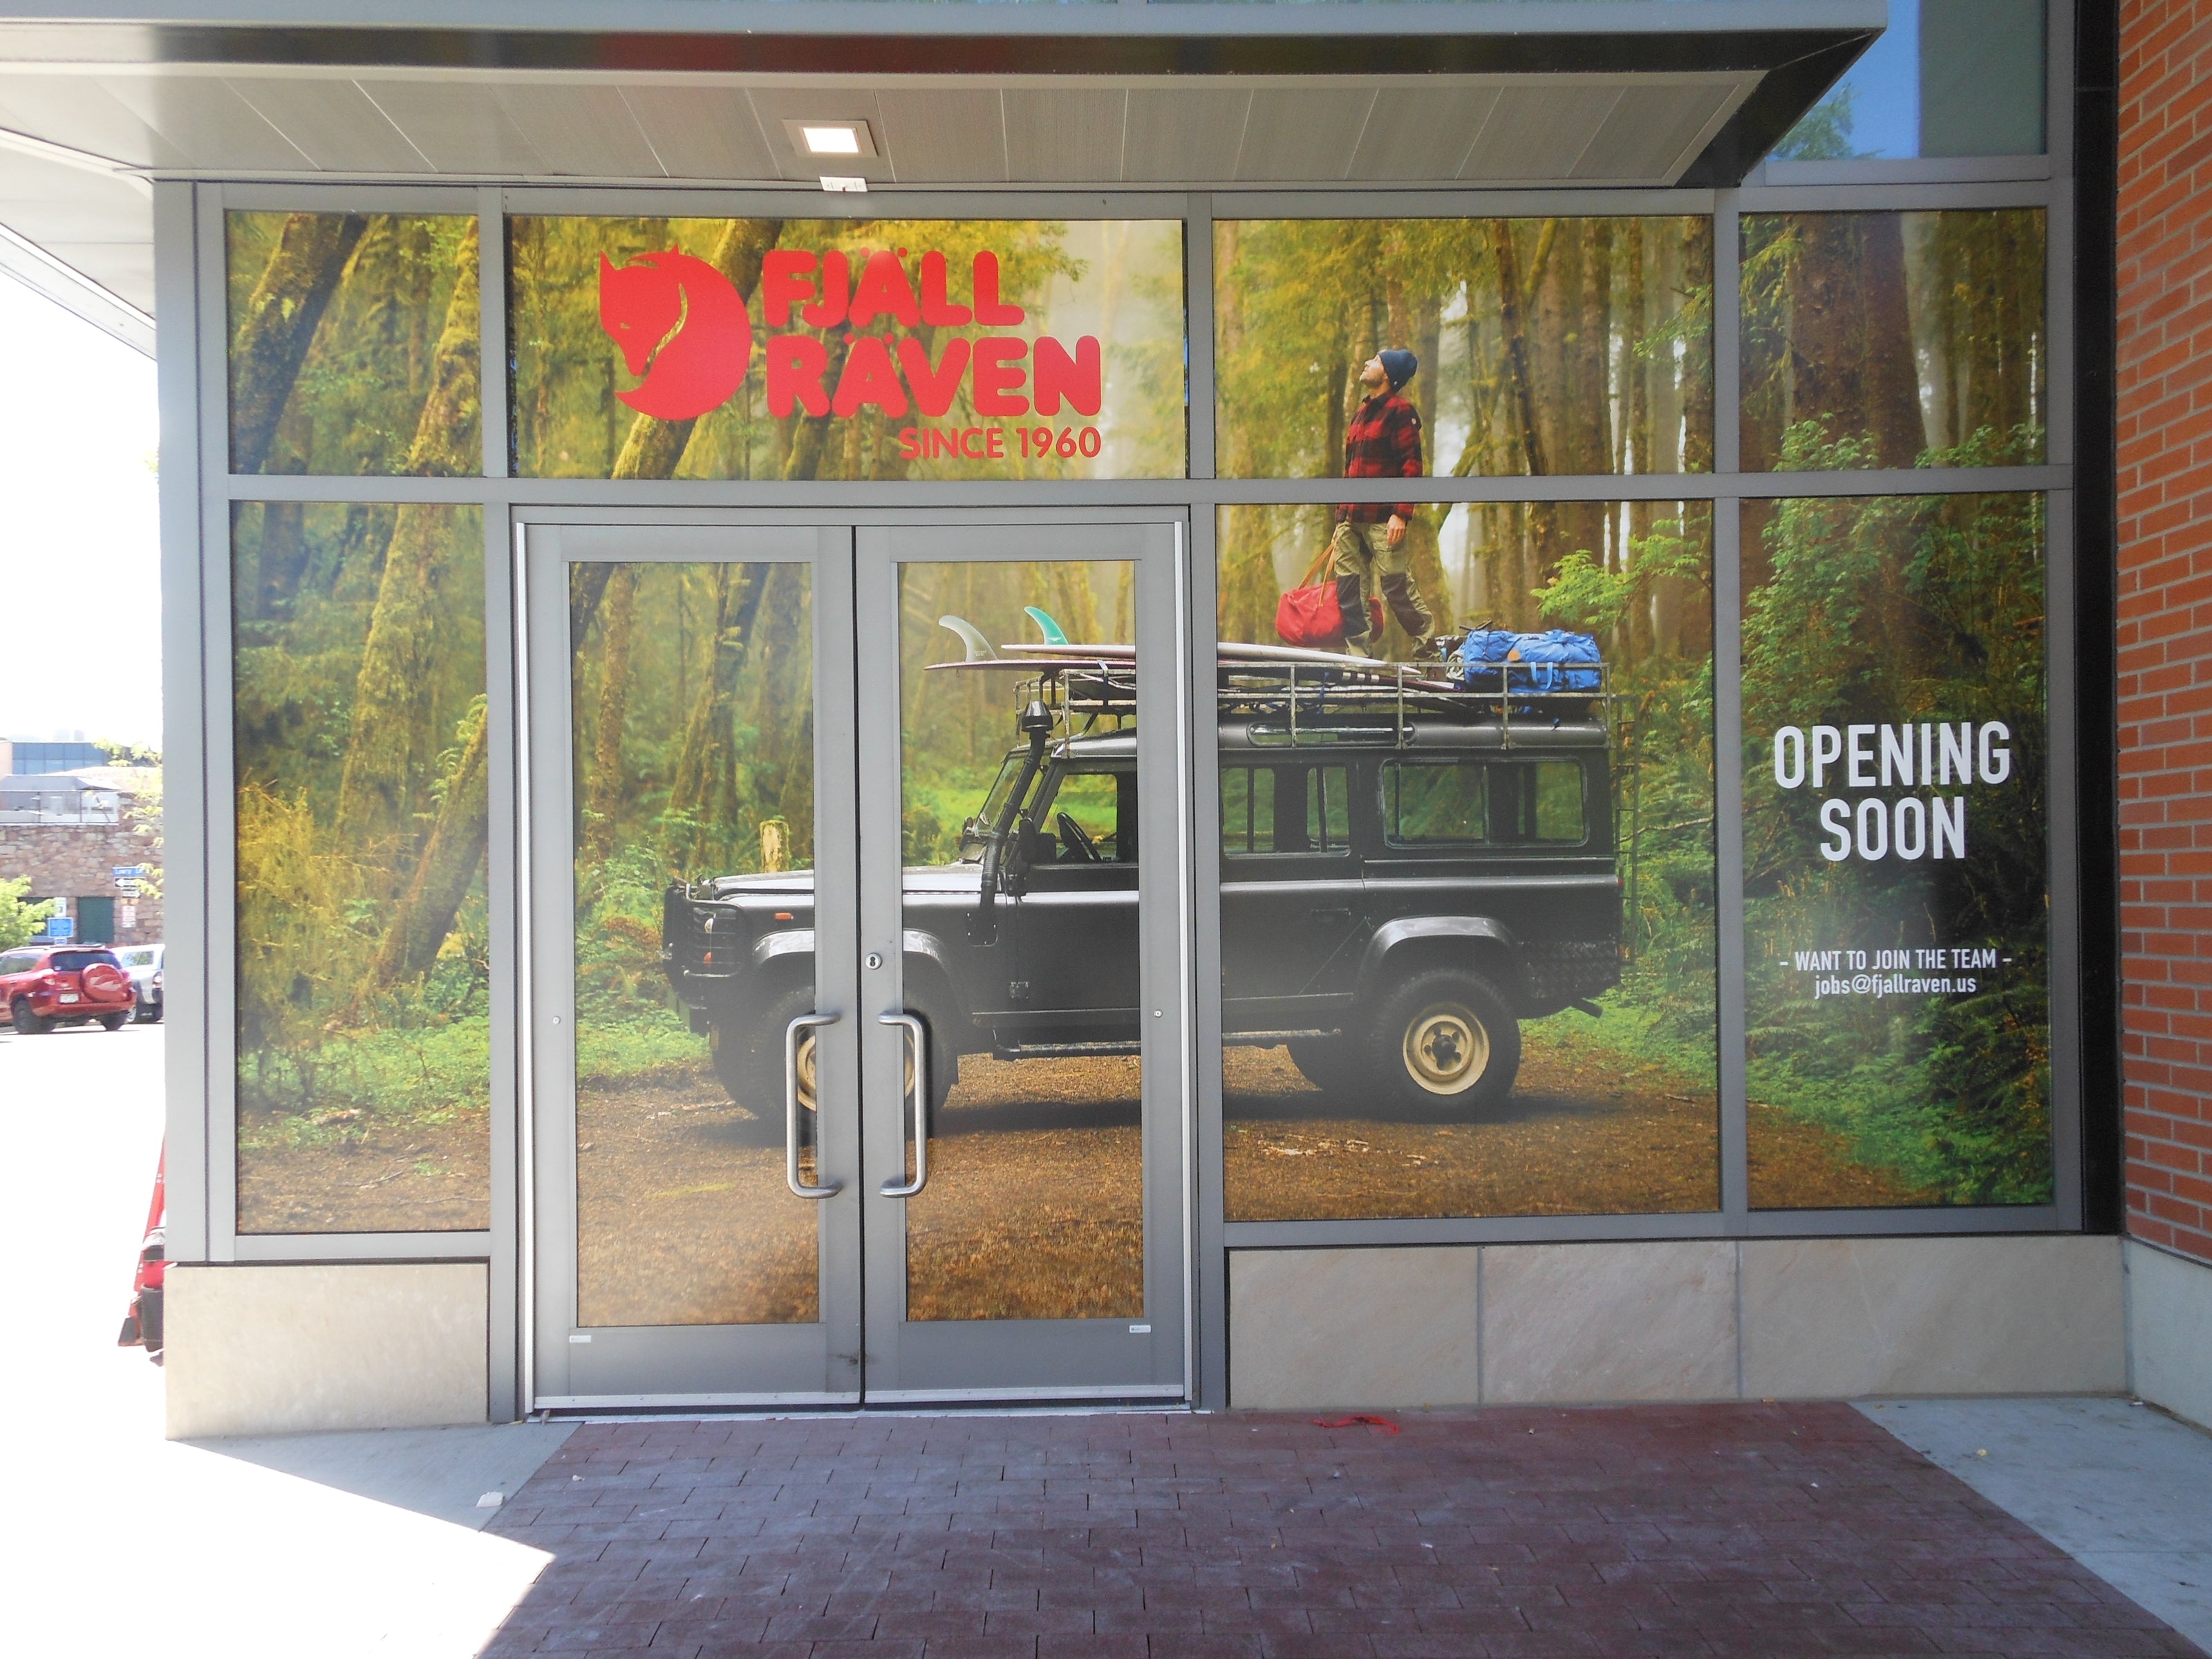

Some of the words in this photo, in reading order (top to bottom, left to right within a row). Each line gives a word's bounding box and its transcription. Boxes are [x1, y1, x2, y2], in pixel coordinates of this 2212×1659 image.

[762, 247, 1025, 328] FJÄLL
[765, 332, 1102, 418] RÄVEN
[899, 427, 1004, 459] SINCE
[1016, 426, 1101, 458] 1960
[1774, 721, 2010, 789] OPENING
[1820, 796, 1965, 862] SOON
[1794, 950, 1841, 971] WANT
[1846, 950, 1867, 971] TO
[1872, 949, 1910, 971] JOIN
[1915, 949, 1947, 969] THE
[1951, 948, 1996, 968] TEAM
[1814, 973, 1977, 1000] jobs@fjallraven.us
